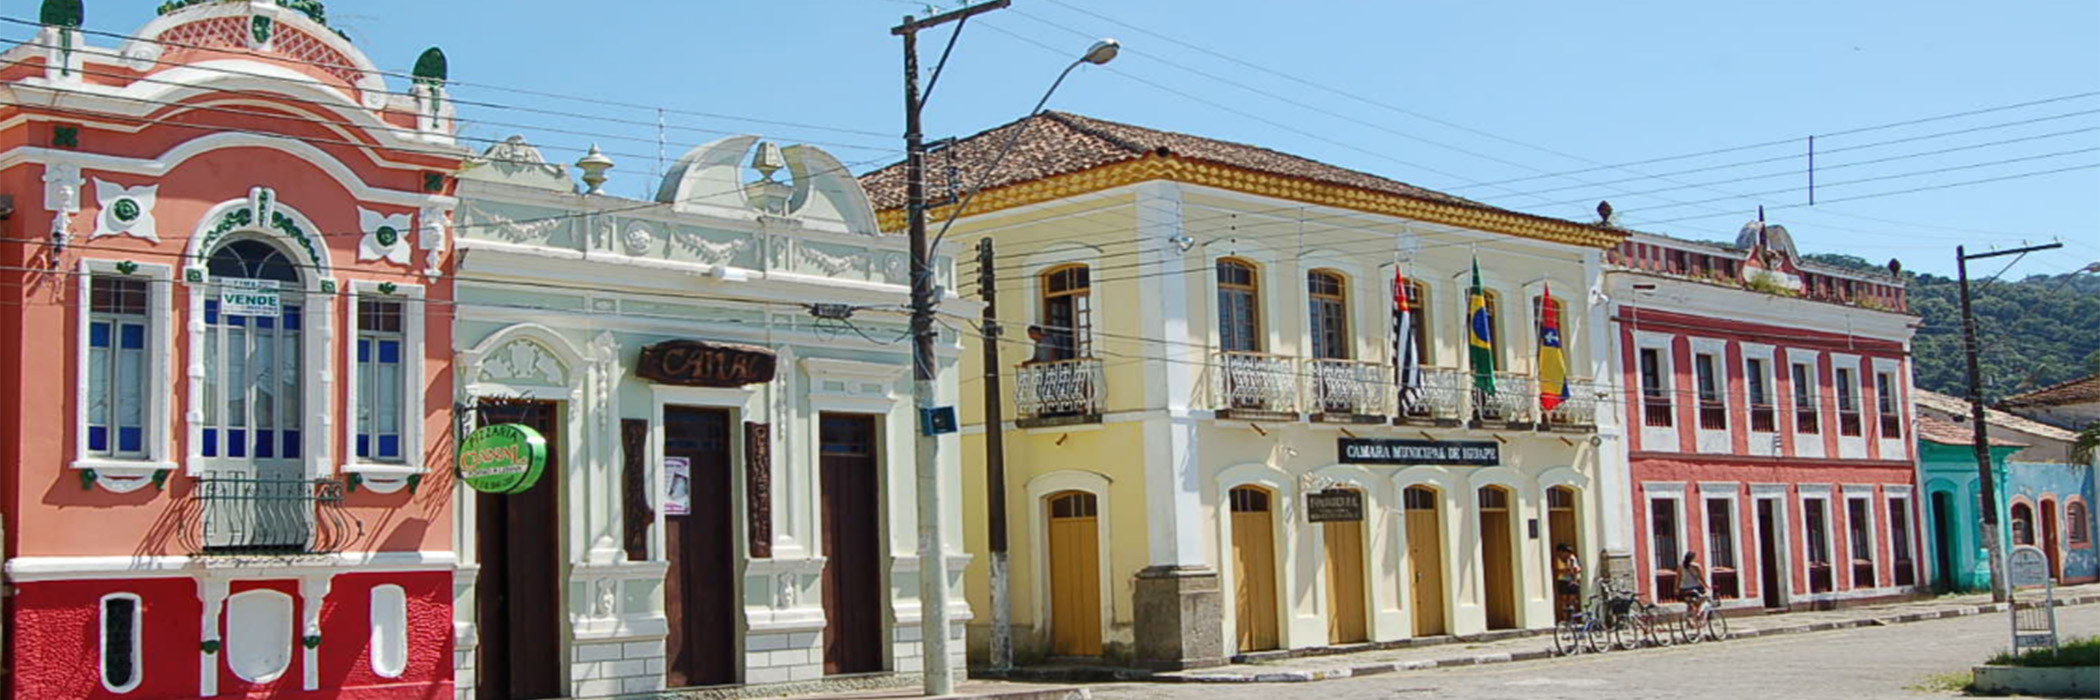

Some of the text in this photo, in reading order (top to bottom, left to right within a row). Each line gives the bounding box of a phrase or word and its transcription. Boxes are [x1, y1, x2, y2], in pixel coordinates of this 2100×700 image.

[224, 294, 277, 306] VENDE
[468, 426, 517, 449] PIZZARIA
[1392, 446, 1445, 460] MUNICIPAL
[1447, 448, 1460, 460] DE
[1462, 448, 1496, 460] IGUAPE
